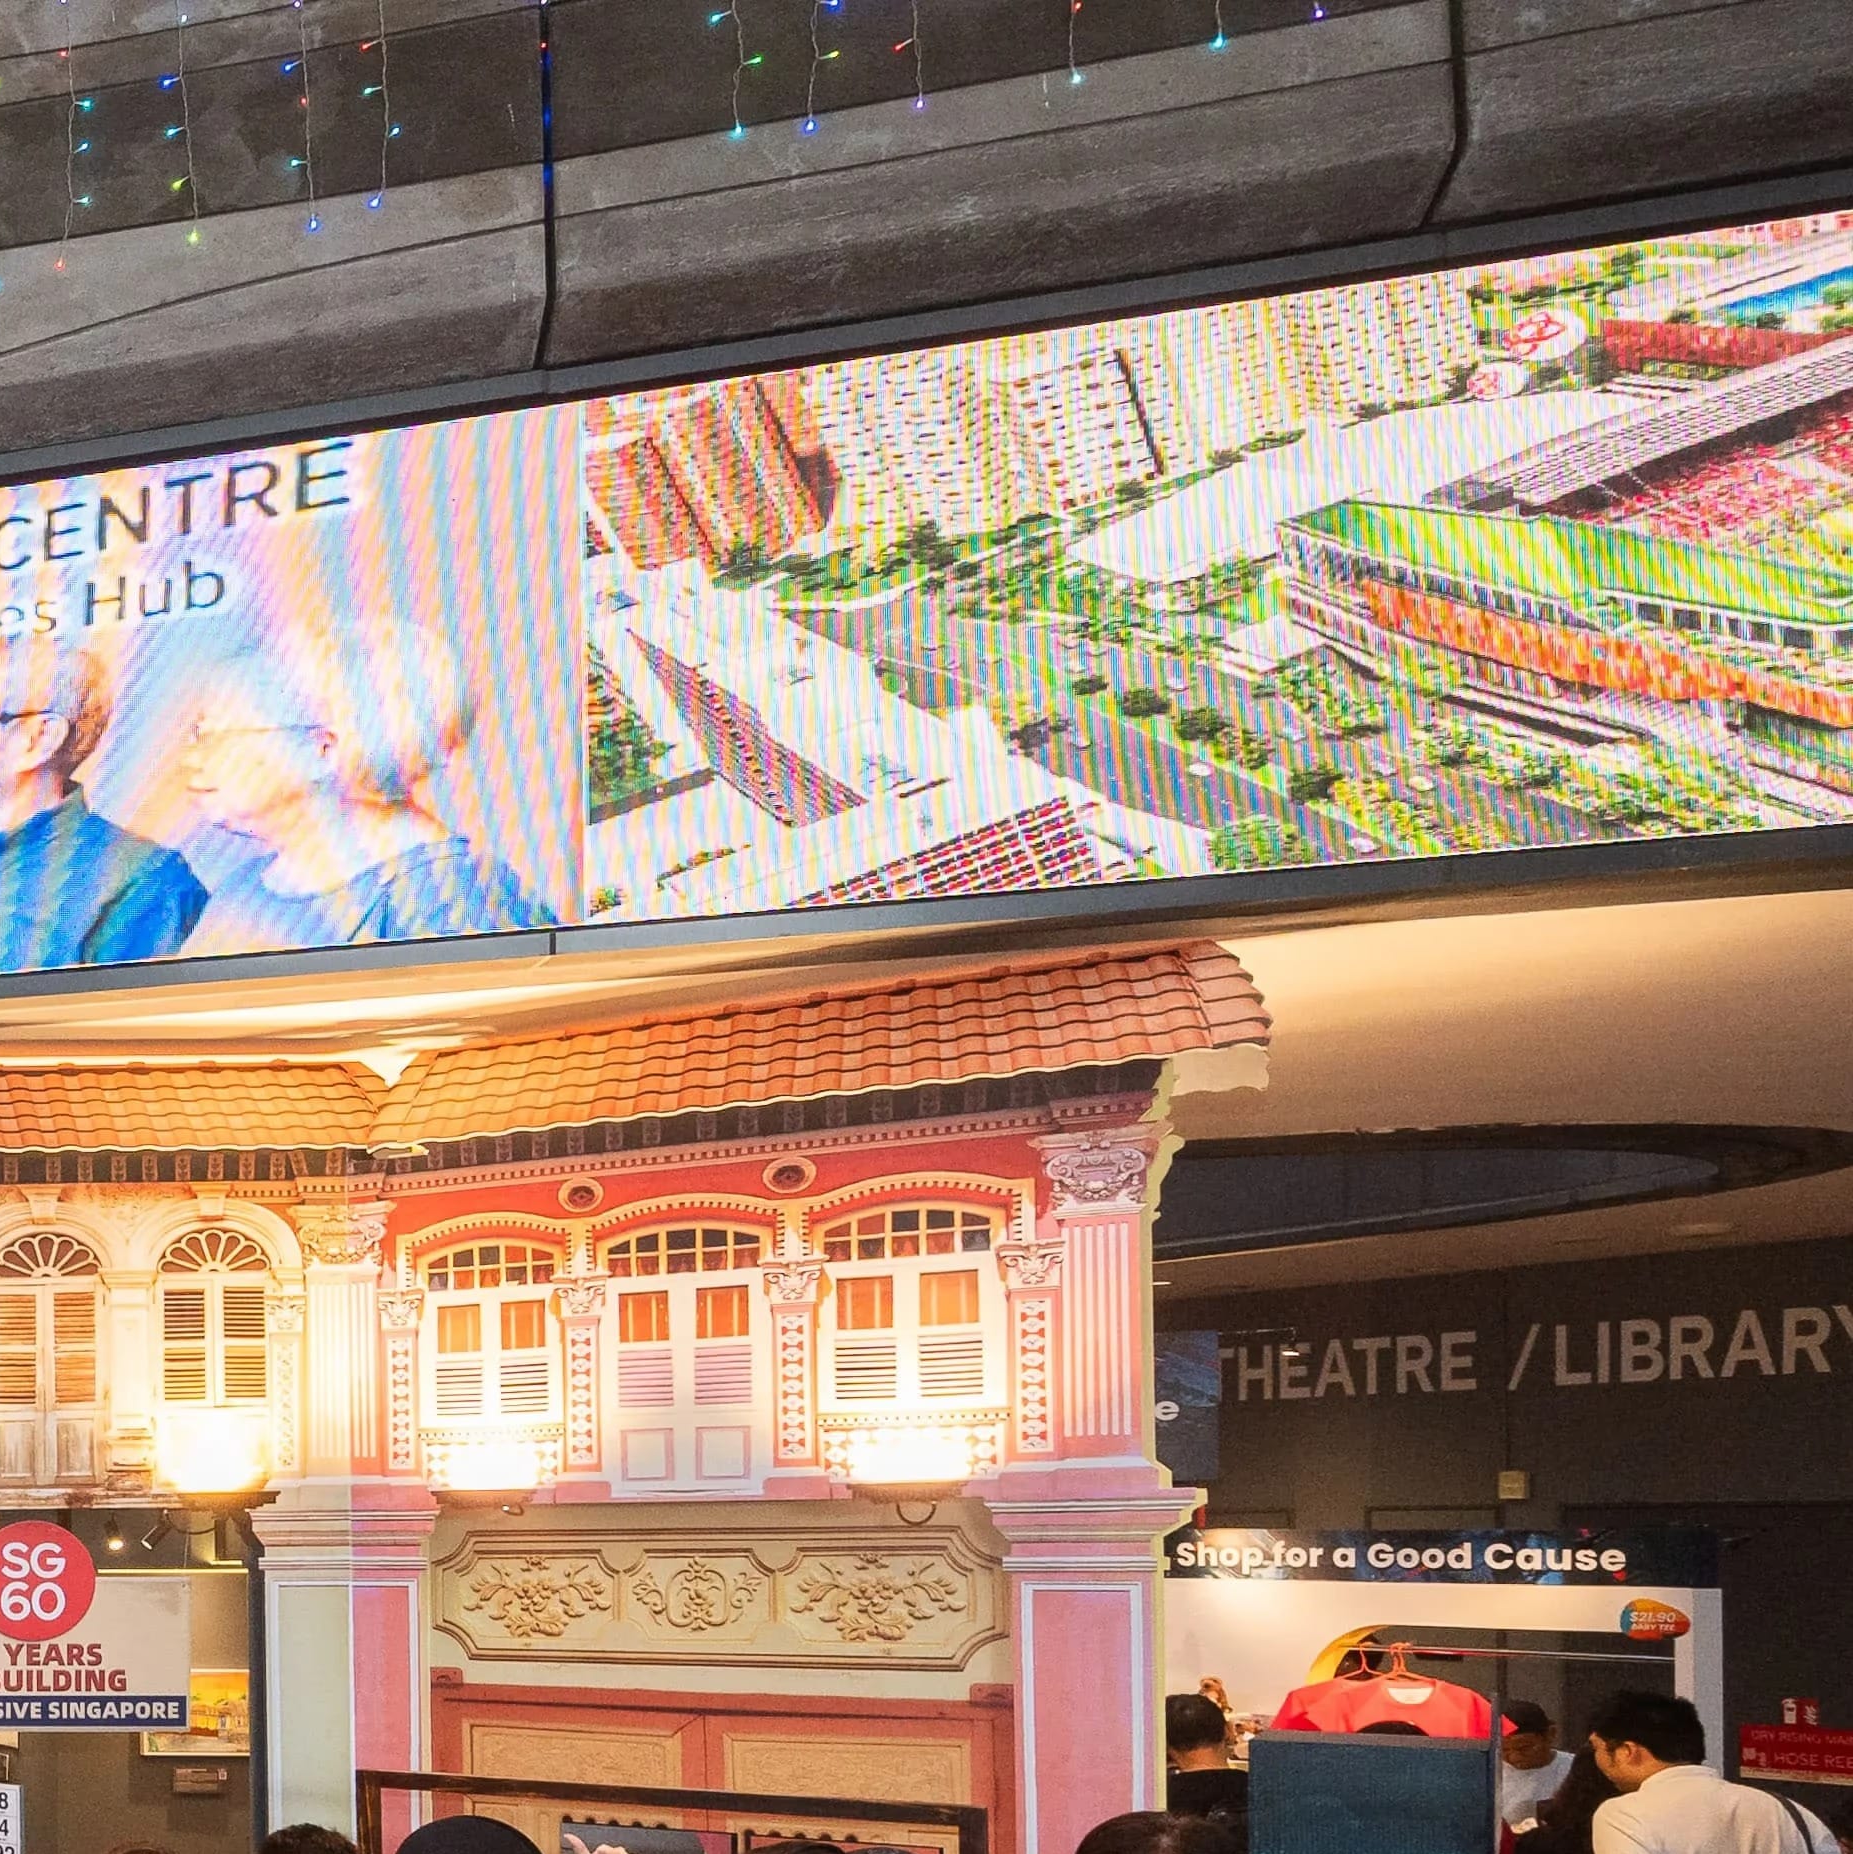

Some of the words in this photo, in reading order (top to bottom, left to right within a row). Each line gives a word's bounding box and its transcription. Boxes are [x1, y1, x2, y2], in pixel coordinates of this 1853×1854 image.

[83, 561, 226, 626] Hub
[0, 1542, 67, 1580] SG
[1176, 1540, 1265, 1573] Shop
[1270, 1539, 1324, 1569] for
[1332, 1544, 1358, 1571] a
[1366, 1541, 1473, 1572] Good
[1483, 1542, 1627, 1575] Cause
[0, 1581, 67, 1622] 60
[3, 1643, 103, 1666] YEARS
[48, 1702, 179, 1719] SINGAPORE
[1778, 1732, 1821, 1744] RISING
[1774, 1752, 1819, 1766] HOSE
